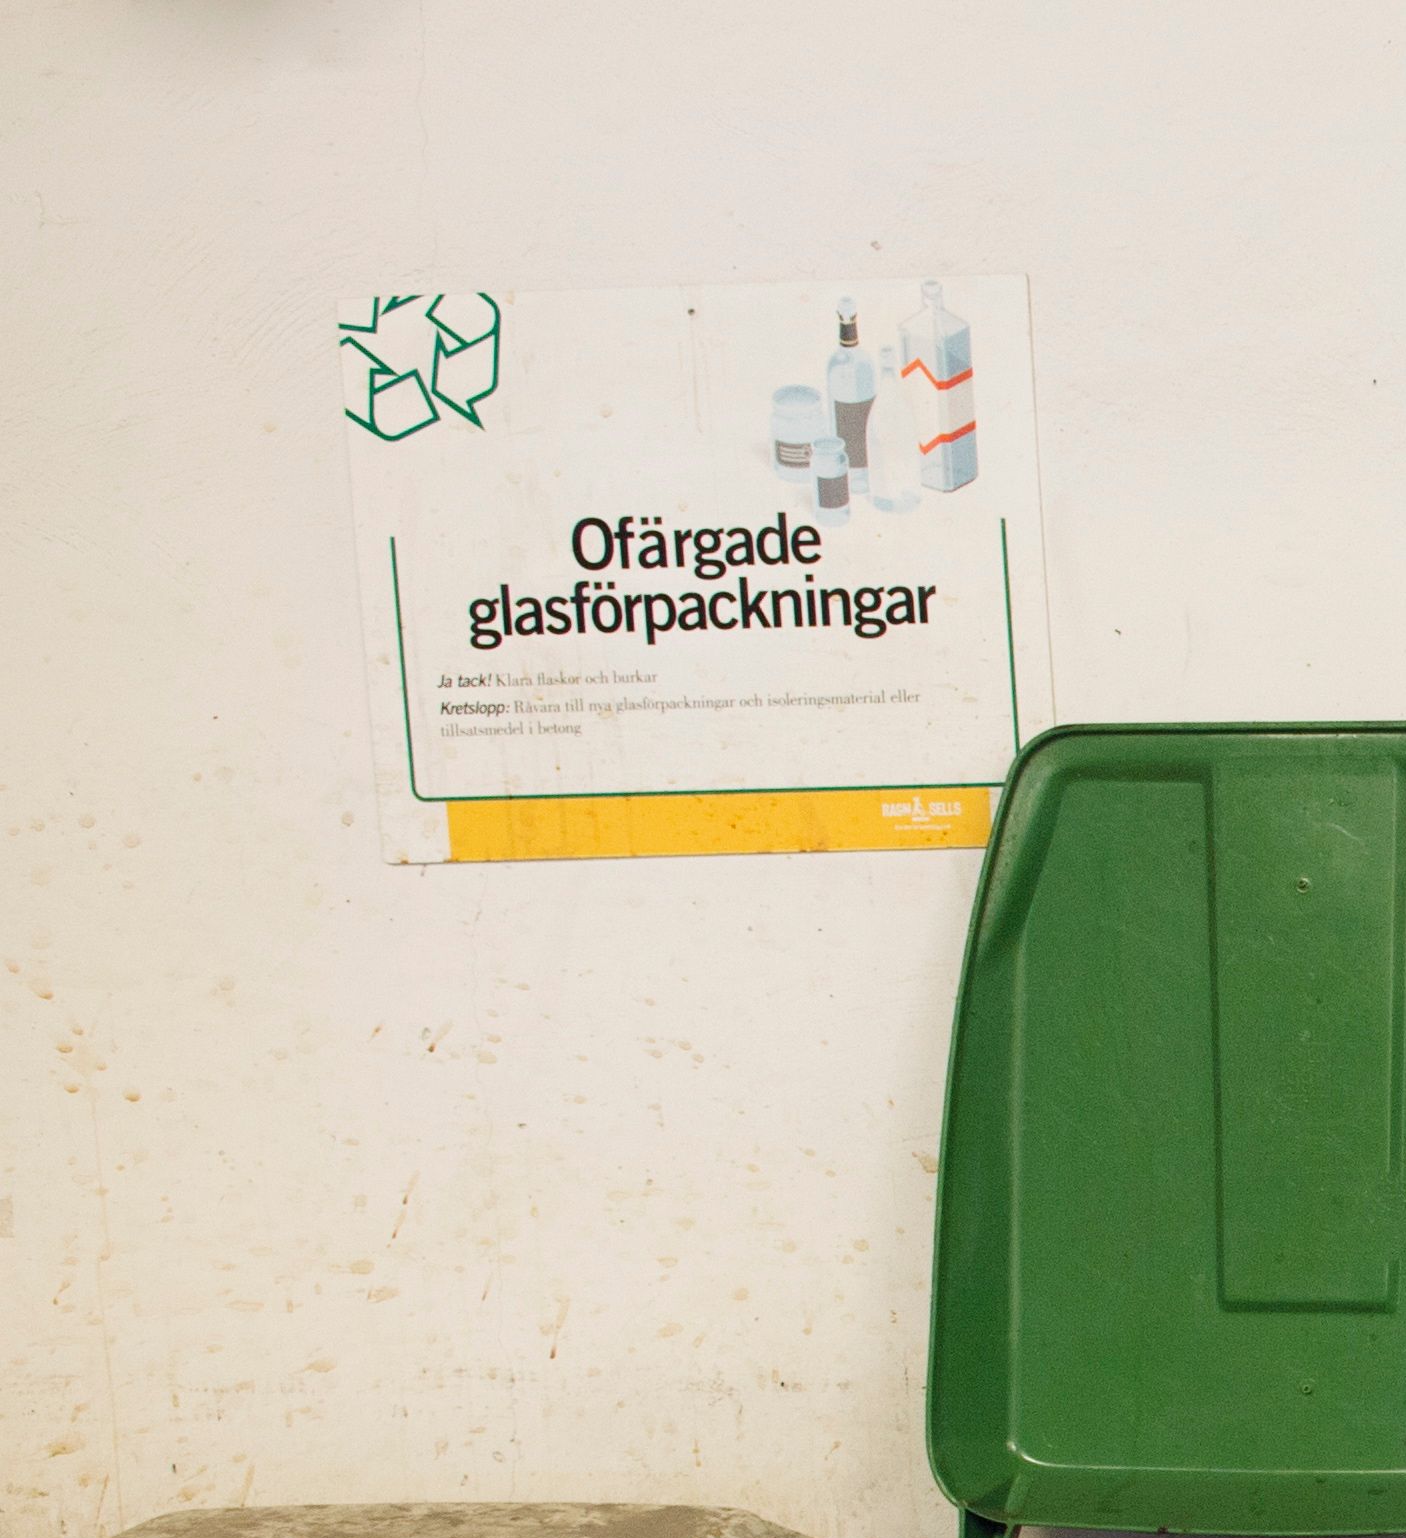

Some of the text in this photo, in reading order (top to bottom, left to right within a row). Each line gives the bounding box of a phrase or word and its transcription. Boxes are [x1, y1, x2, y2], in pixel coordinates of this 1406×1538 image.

[571, 512, 822, 580] Ofärgade
[469, 574, 936, 650] glasförpackningar
[437, 669, 657, 688] Ja tack! Klara flaskor och burkar
[440, 690, 921, 716] Kretslopp: Råvara till nya glasförpackningar och isoleringsmaterial eller
[440, 722, 524, 737] tillsatsmedel
[537, 721, 582, 737] betong
